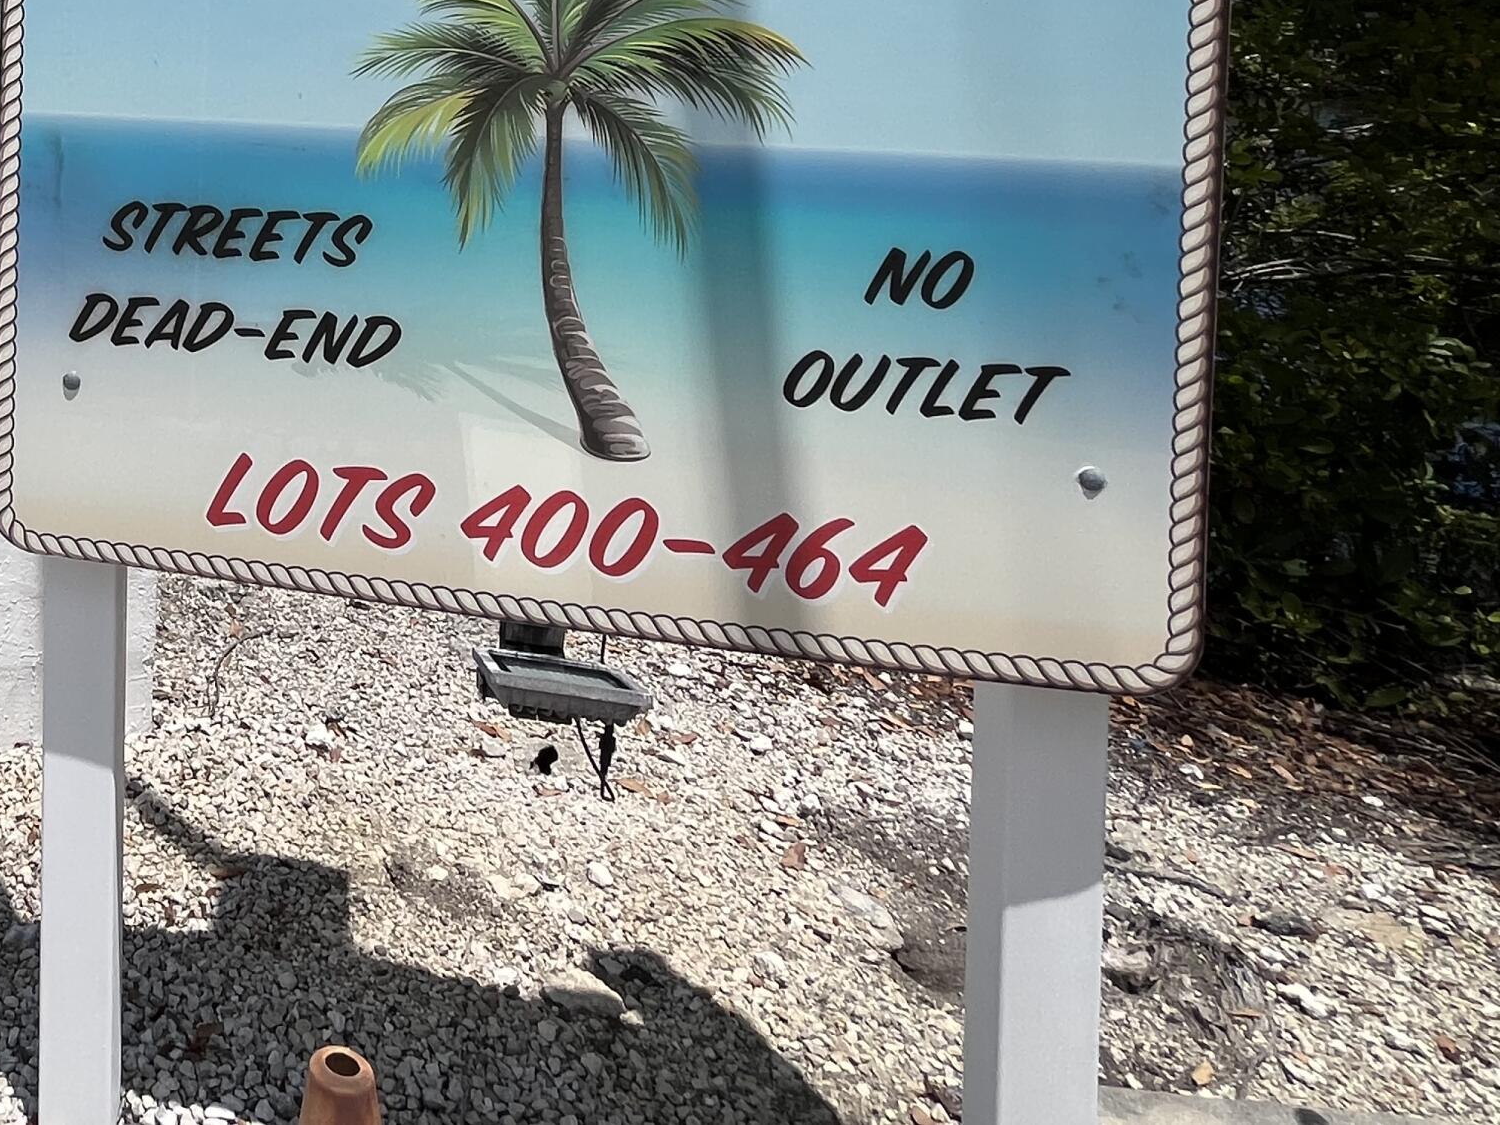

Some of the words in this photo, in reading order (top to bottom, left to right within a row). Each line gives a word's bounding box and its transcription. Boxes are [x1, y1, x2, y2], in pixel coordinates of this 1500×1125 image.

[102, 200, 373, 268] STREETS
[864, 247, 975, 310] NO
[68, 293, 402, 368] DEAD-END
[782, 350, 1071, 425] OUTLET
[206, 452, 436, 550] LOTS
[460, 484, 929, 607] 400-464
